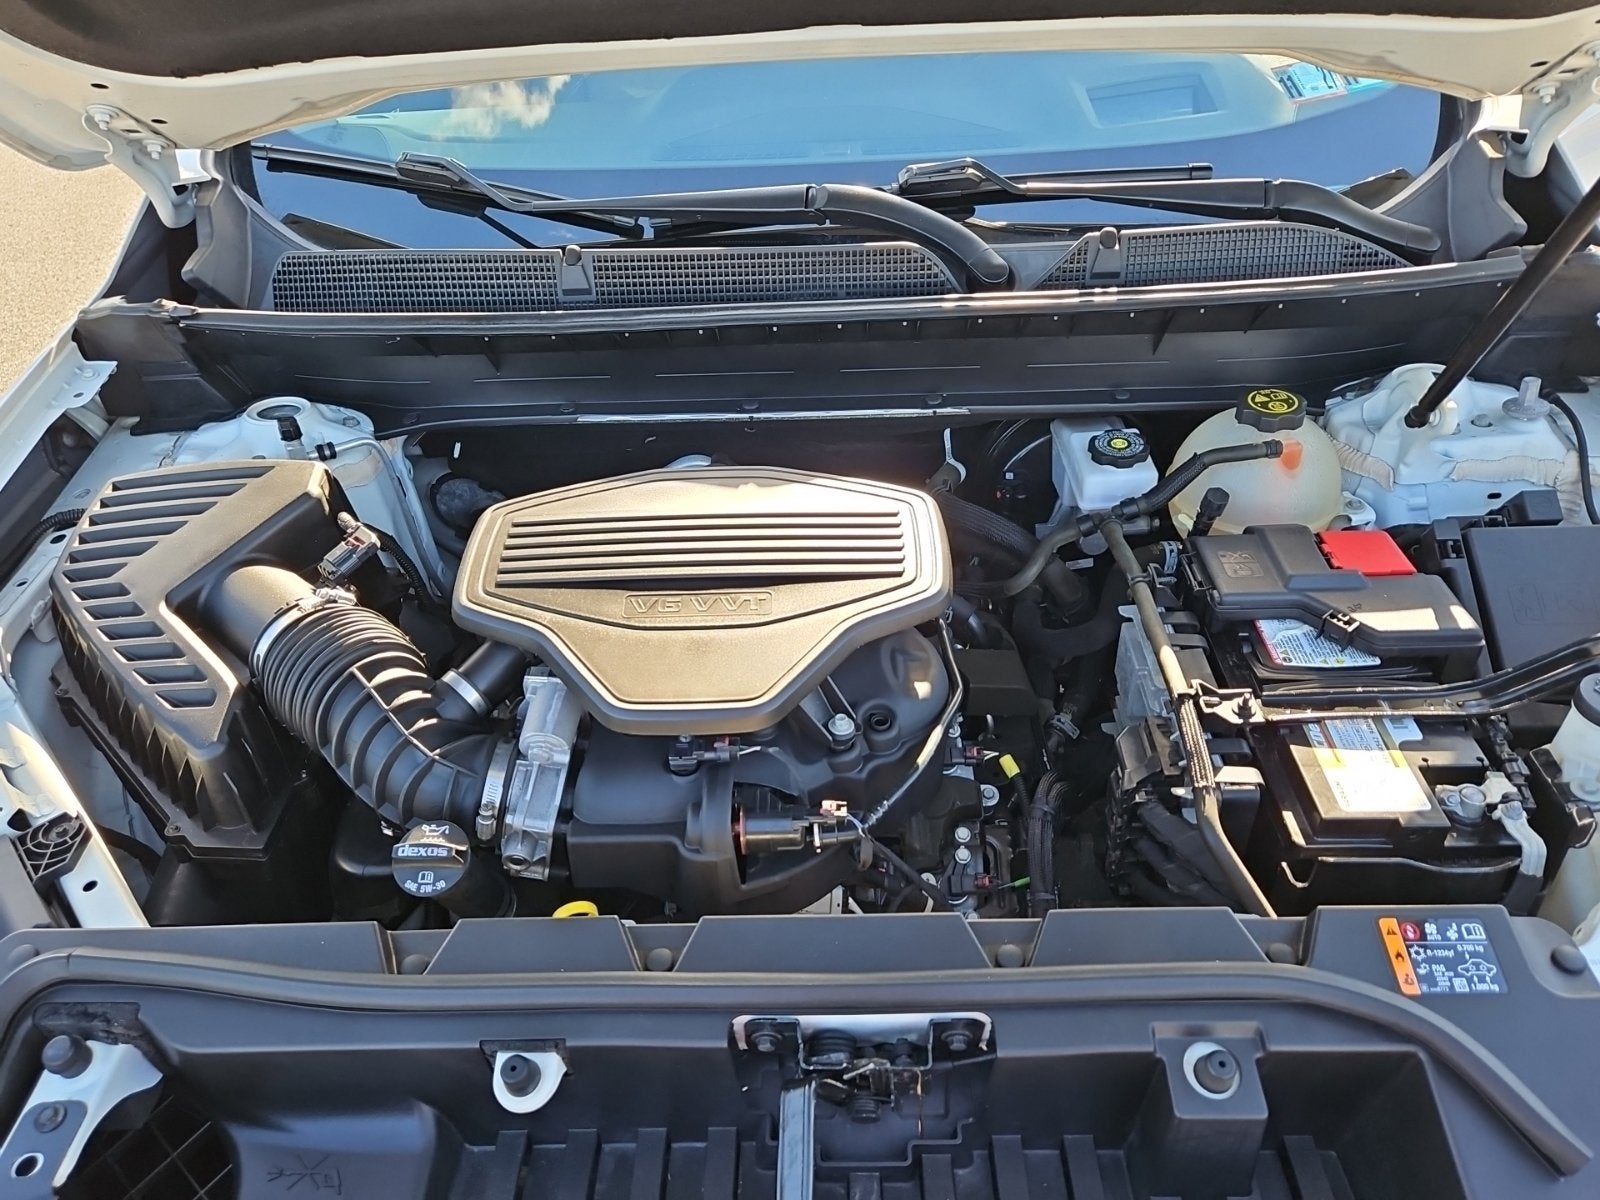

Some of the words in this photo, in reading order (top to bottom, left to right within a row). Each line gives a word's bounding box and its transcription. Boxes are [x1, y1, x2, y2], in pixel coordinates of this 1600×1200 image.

[629, 597, 682, 613] V6
[689, 594, 767, 612] VVT
[397, 844, 449, 857] dexos
[404, 880, 418, 892] SAE
[420, 879, 446, 893] 5W-30
